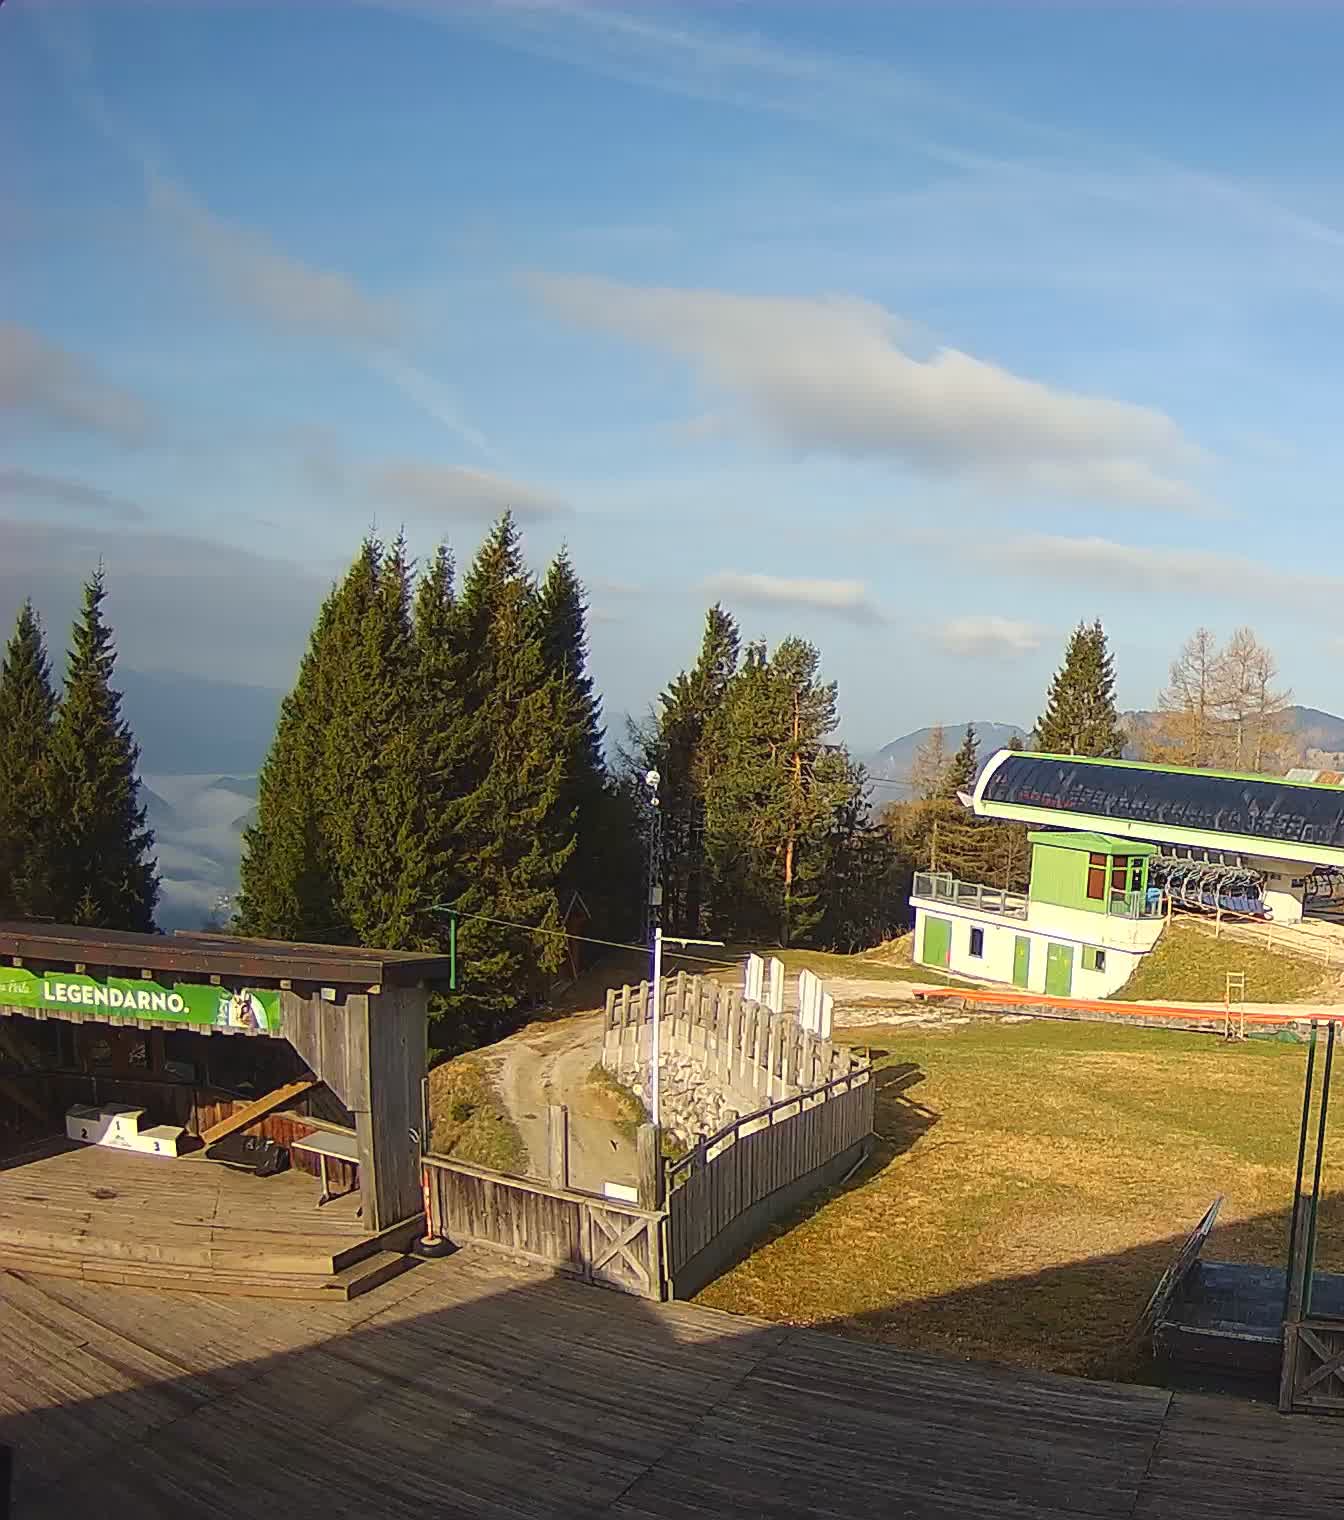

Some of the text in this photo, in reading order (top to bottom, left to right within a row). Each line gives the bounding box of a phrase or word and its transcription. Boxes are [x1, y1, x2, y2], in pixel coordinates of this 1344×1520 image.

[43, 981, 190, 1014] LEGENDARNO.
[81, 1128, 88, 1139] 2
[153, 1141, 160, 1151] 3
